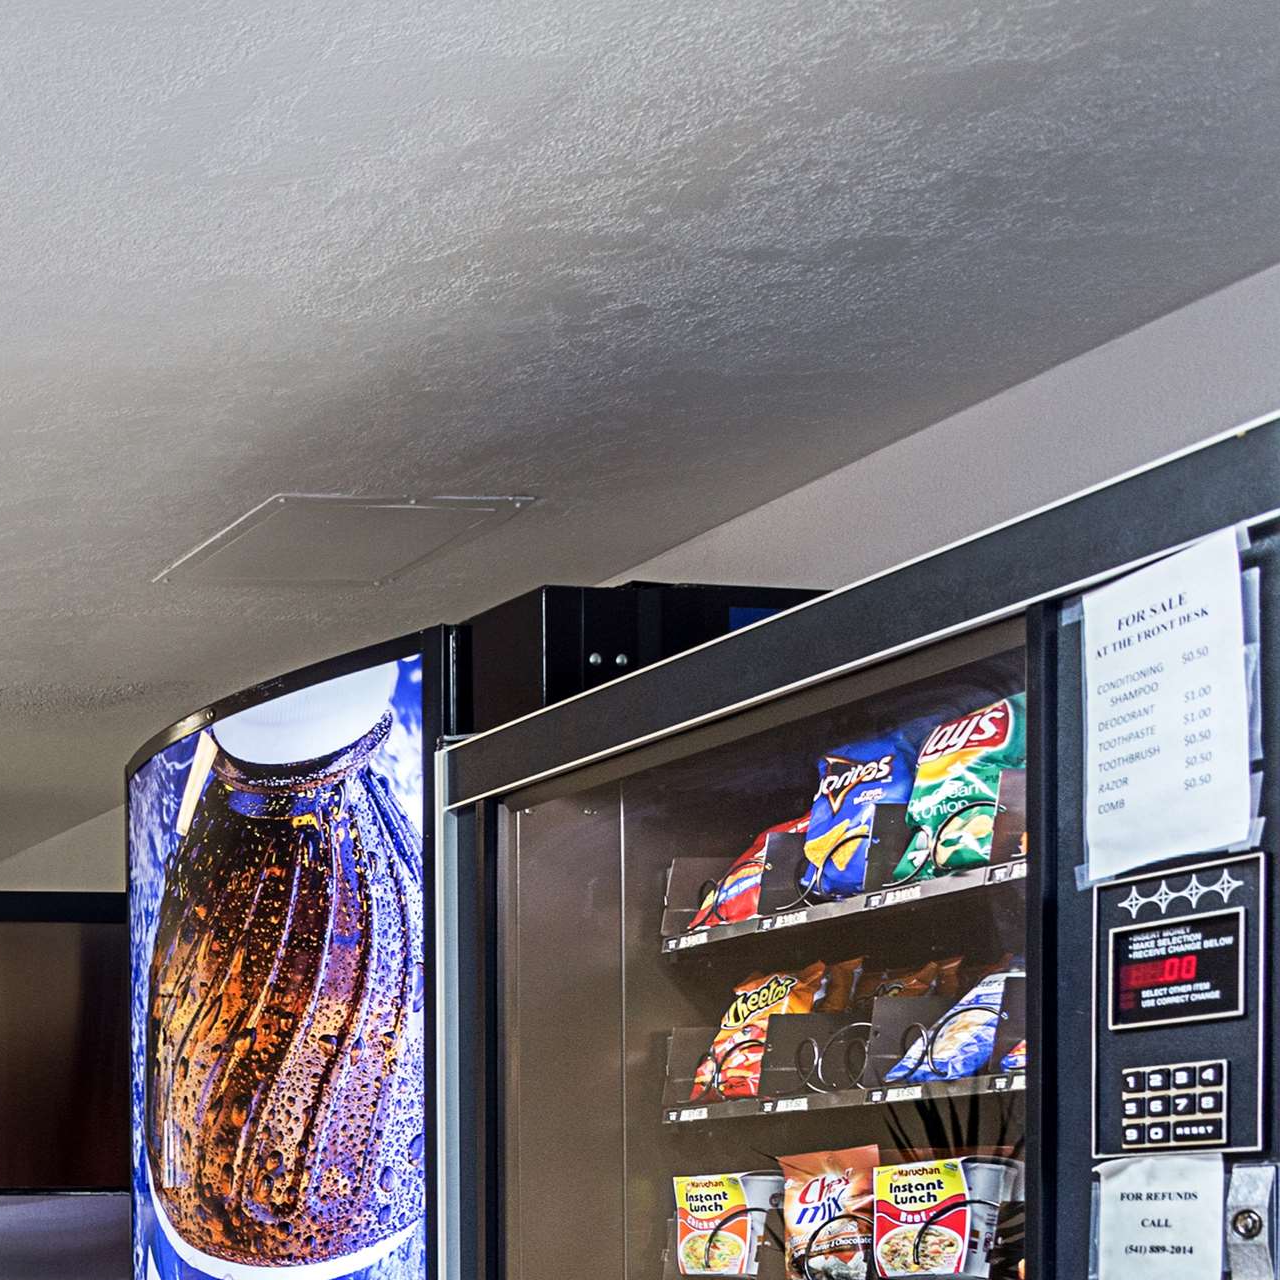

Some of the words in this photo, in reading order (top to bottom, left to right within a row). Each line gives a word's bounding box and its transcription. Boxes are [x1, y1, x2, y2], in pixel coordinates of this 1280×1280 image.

[1117, 609, 1145, 631] FOR
[1149, 592, 1188, 617] SALE
[1095, 645, 1109, 659] AT
[1112, 638, 1134, 653] THE
[1137, 620, 1175, 642] FRONT
[1179, 607, 1209, 627] DESK
[1097, 662, 1165, 696] CONDITIONING
[1181, 645, 1209, 664] $0.50
[1109, 681, 1159, 707] SHAMPOO
[1097, 704, 1155, 732] DEODORANT
[1184, 685, 1211, 703] $1.00
[1098, 725, 1157, 752] TOOTHPASTE
[1183, 707, 1211, 725] $1.00
[1098, 745, 1160, 773] TOOTHBRUSH
[1184, 729, 1211, 746] $0.50
[1098, 776, 1129, 794] RAZOR
[1185, 752, 1212, 768] $0.50
[1097, 798, 1125, 815] COMB
[1183, 773, 1211, 790] $0.50
[1162, 926, 1191, 937] MONEY
[1132, 940, 1155, 951] MAKE
[1157, 933, 1202, 947] SELECTION
[1133, 947, 1166, 959] RECEIVE
[1168, 941, 1202, 954] CHANGE
[1203, 936, 1234, 949] BELOW
[723, 975, 797, 1028] Cheetos
[1141, 988, 1168, 998] SELECT
[1141, 998, 1155, 1008] USE
[1190, 990, 1221, 1001] CHANGE
[1126, 1076, 1135, 1088] 1
[1149, 1073, 1163, 1087] 2
[1174, 1071, 1188, 1084] 3
[1201, 1067, 1215, 1081] 4
[1124, 1102, 1137, 1115] 5
[1149, 1100, 1163, 1112] 6
[1175, 1097, 1189, 1111] 7
[1200, 1096, 1214, 1109] 8
[1125, 1128, 1138, 1141] 9
[1149, 1127, 1163, 1140] 0
[1175, 1125, 1214, 1135] RESET
[897, 1166, 940, 1177] Maruchan
[889, 1179, 944, 1194] Instant
[685, 1191, 728, 1203] Instant
[894, 1192, 938, 1205] Lunch
[1120, 1192, 1143, 1201] FOR
[1146, 1192, 1198, 1201] REFUNDS
[689, 1202, 723, 1213] Lunch
[1141, 1218, 1172, 1228] CALL
[834, 1237, 873, 1245] Chocolate
